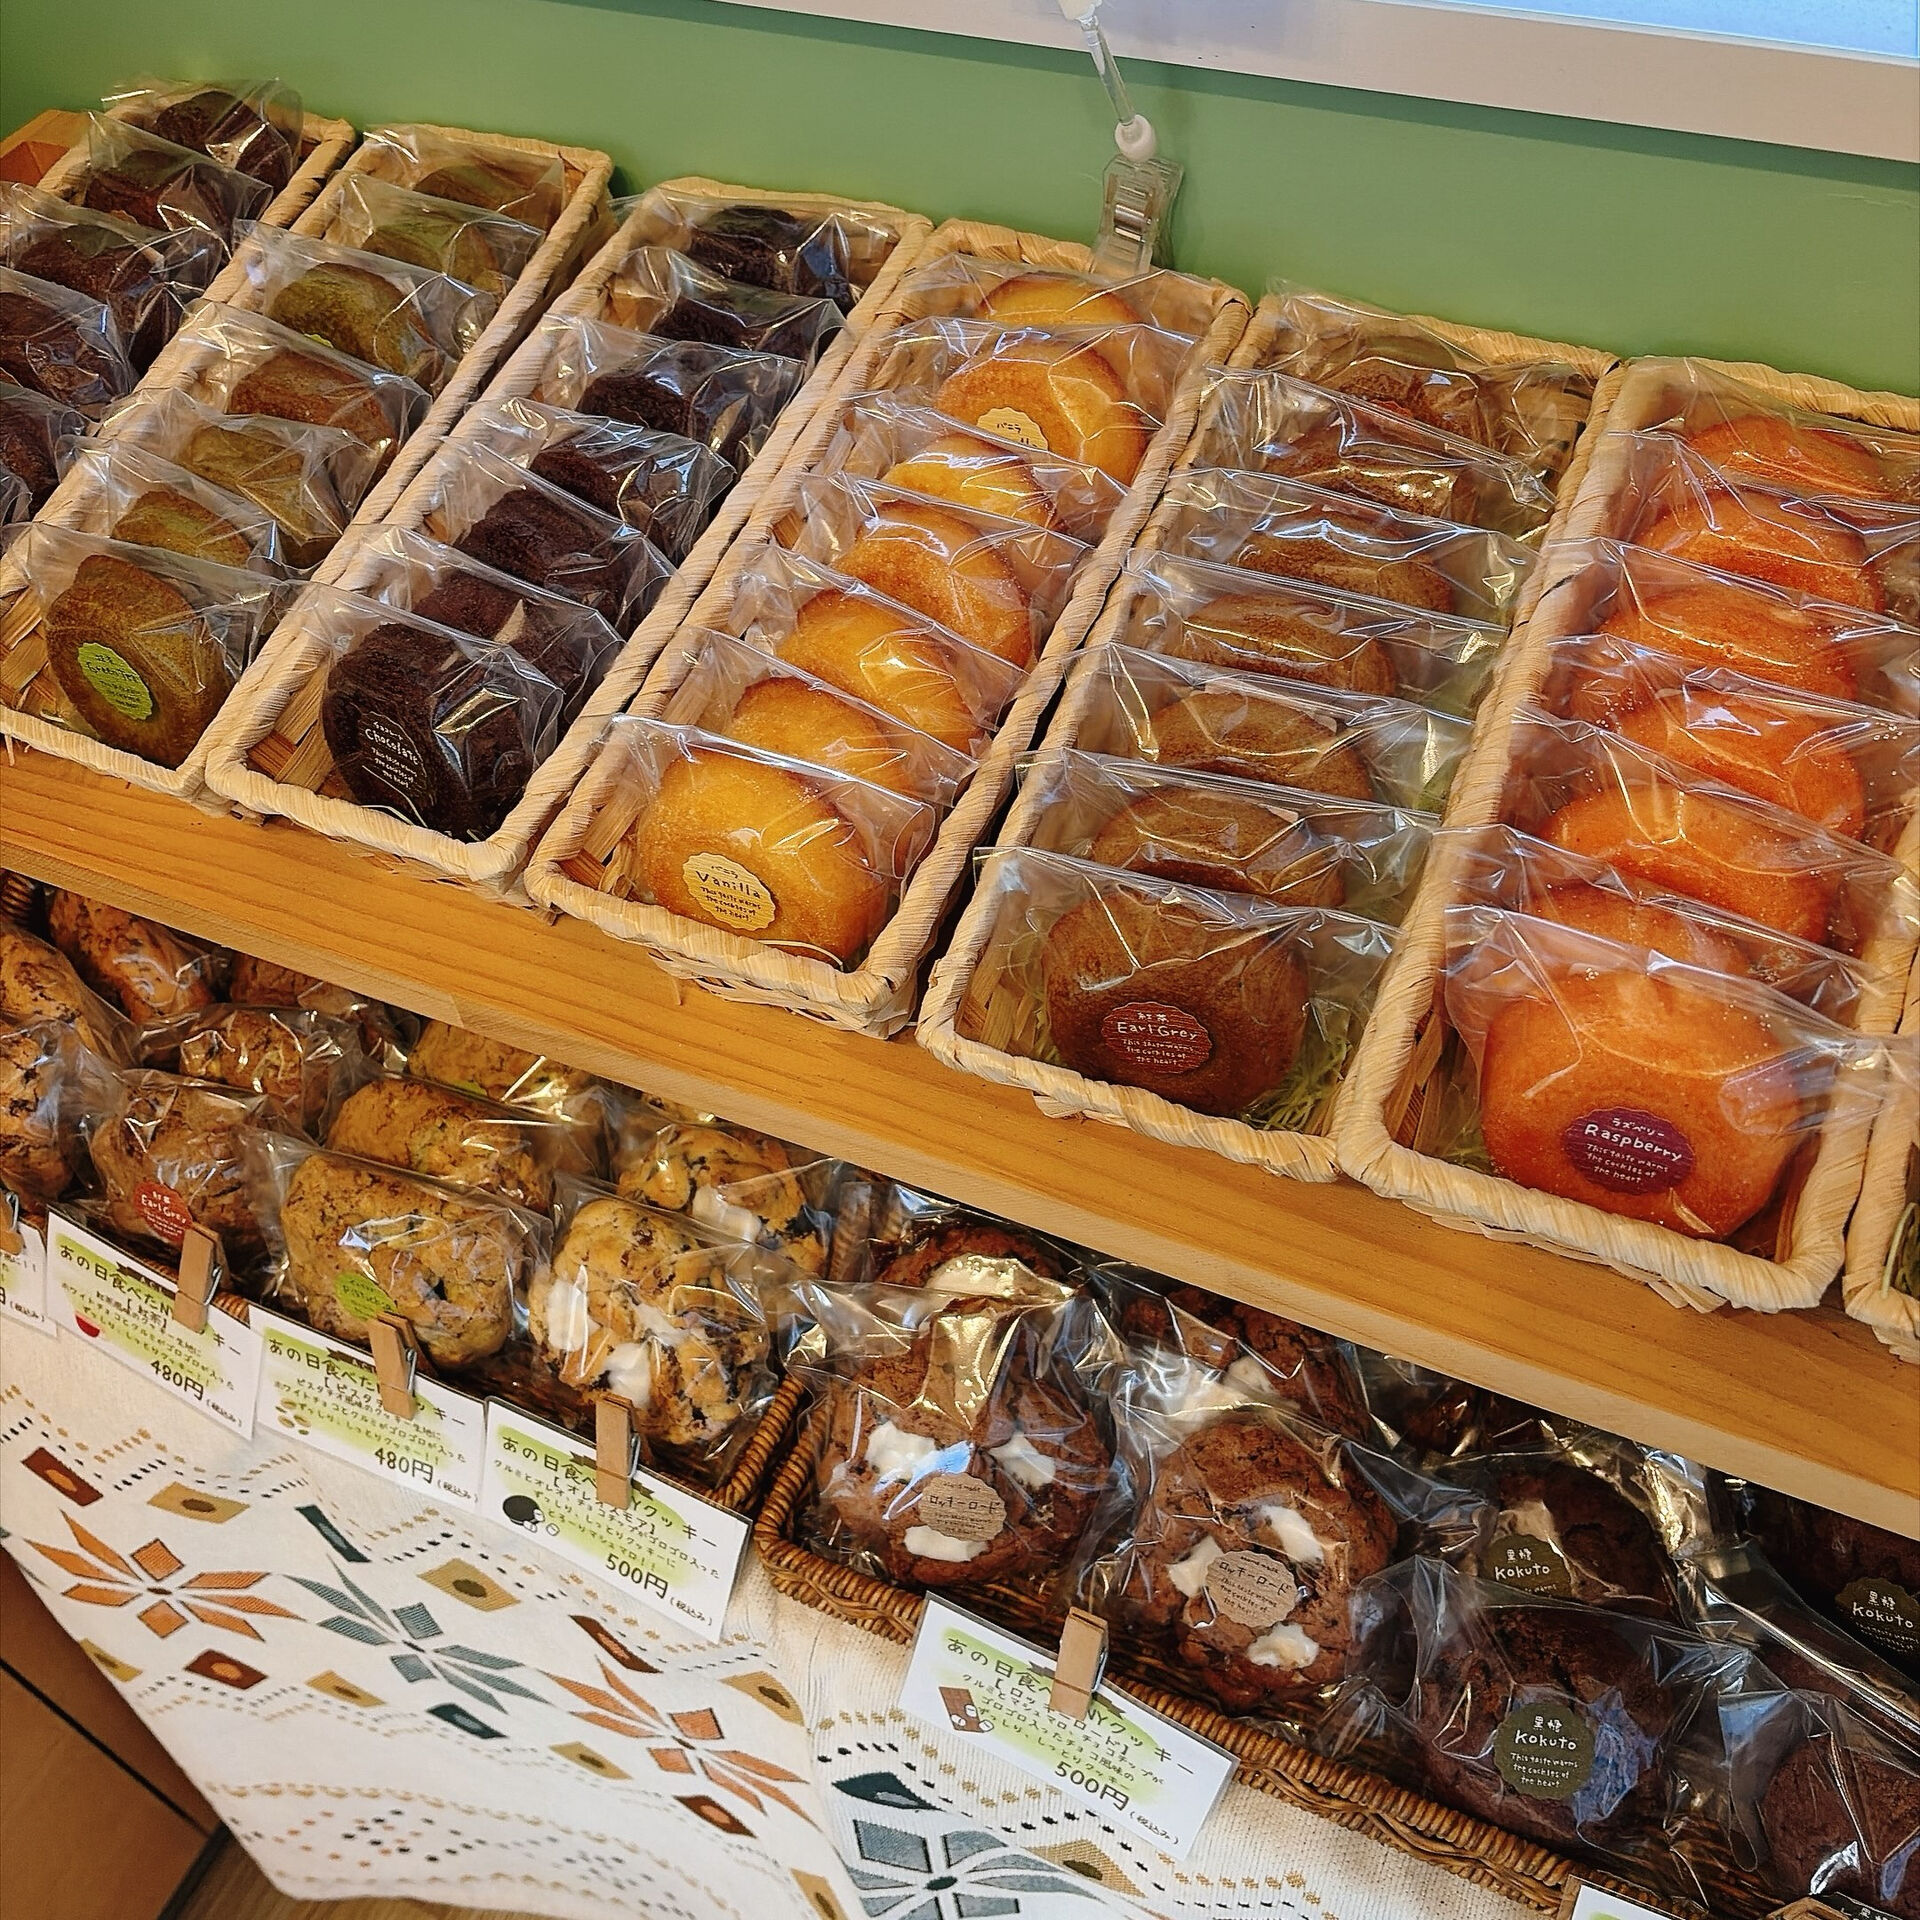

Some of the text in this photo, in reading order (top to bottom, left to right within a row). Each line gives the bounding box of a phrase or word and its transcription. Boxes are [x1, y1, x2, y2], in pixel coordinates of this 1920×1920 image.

[997, 422, 1021, 434] バニラ
[695, 870, 762, 899] Vanilla
[1117, 1021, 1199, 1041] Earl Grey
[1584, 1123, 1683, 1162] Raspberry
[1612, 1117, 1665, 1137] ラズベリー
[150, 1359, 203, 1401] 480円
[374, 1446, 433, 1484] 480円
[605, 1553, 668, 1600] 500円
[1219, 1561, 1293, 1596] ロッキーロード
[1494, 1563, 1551, 1581] Kokuto
[1852, 1601, 1914, 1629] Kokuto
[980, 1695, 1136, 1782] ゴロゴロ入ったチョコ風味の
[1514, 1729, 1577, 1750] Kokuto
[1533, 1715, 1563, 1733] 黒糖
[976, 1706, 1130, 1789] ずっしり、しっとりクッキー
[1053, 1760, 1130, 1810] 500円
